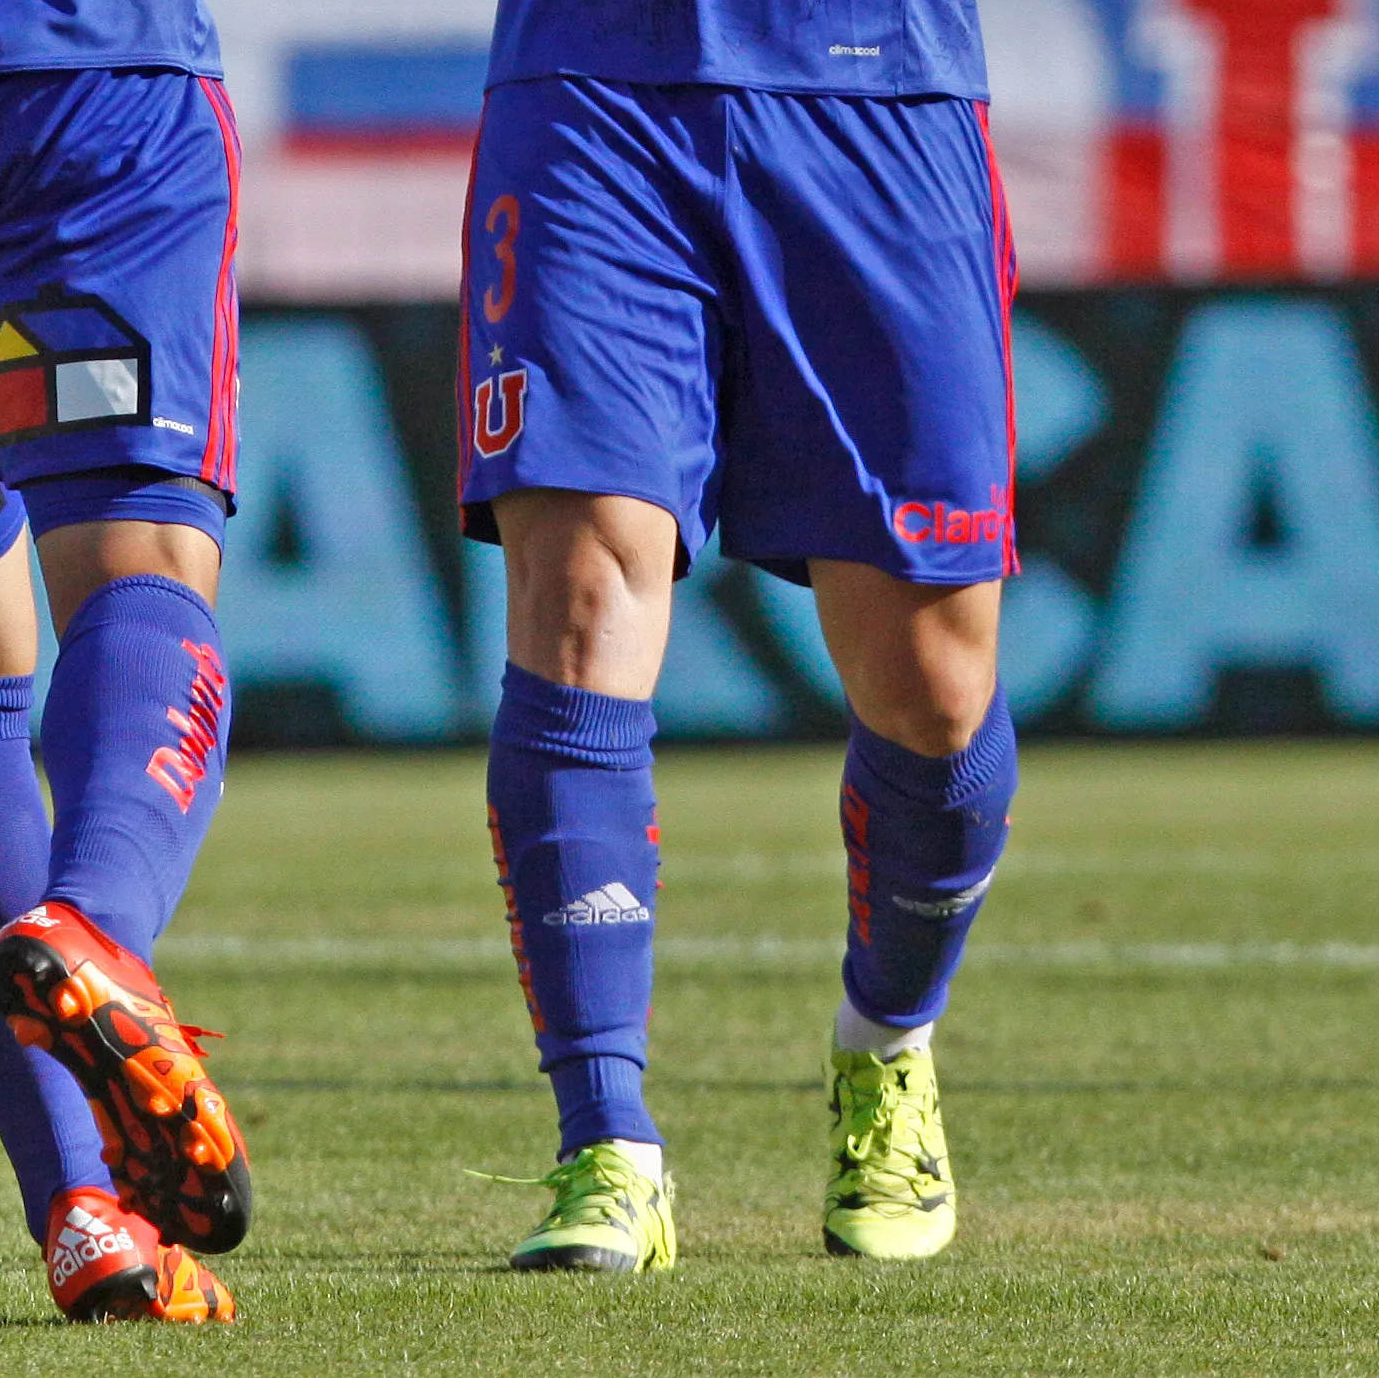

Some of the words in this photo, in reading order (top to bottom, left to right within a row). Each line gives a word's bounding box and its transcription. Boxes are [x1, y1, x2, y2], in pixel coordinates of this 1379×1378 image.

[828, 44, 881, 57] climacool
[483, 193, 520, 325] 3
[474, 368, 528, 459] U
[893, 501, 1001, 545] Claro
[542, 903, 651, 926] adidas
[52, 1226, 134, 1287] adidas
